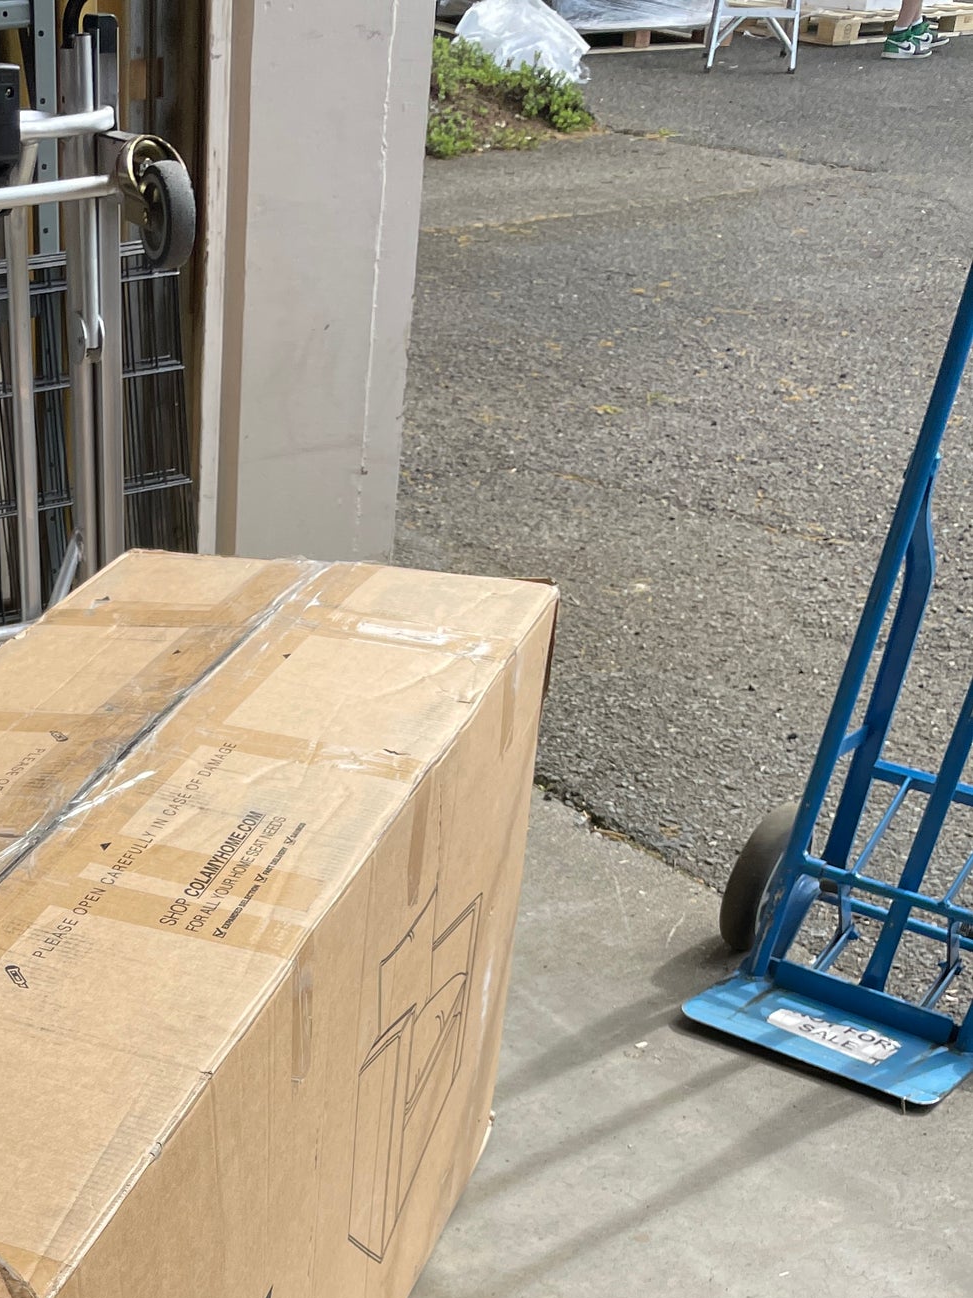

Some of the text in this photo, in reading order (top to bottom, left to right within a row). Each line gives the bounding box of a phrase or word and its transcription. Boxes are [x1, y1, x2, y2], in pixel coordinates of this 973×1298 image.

[7, 748, 45, 776] PLEASE
[32, 741, 237, 959] PLEASE OPEN CAREFULLY IN CASE OF DAMAGE
[159, 810, 265, 926] SHOP COLAMYHOME.COM
[185, 816, 287, 932] FOR ALL YOUR HOME SEAT NEEDS
[798, 1023, 859, 1051] SALE
[843, 1026, 893, 1050] FOR
